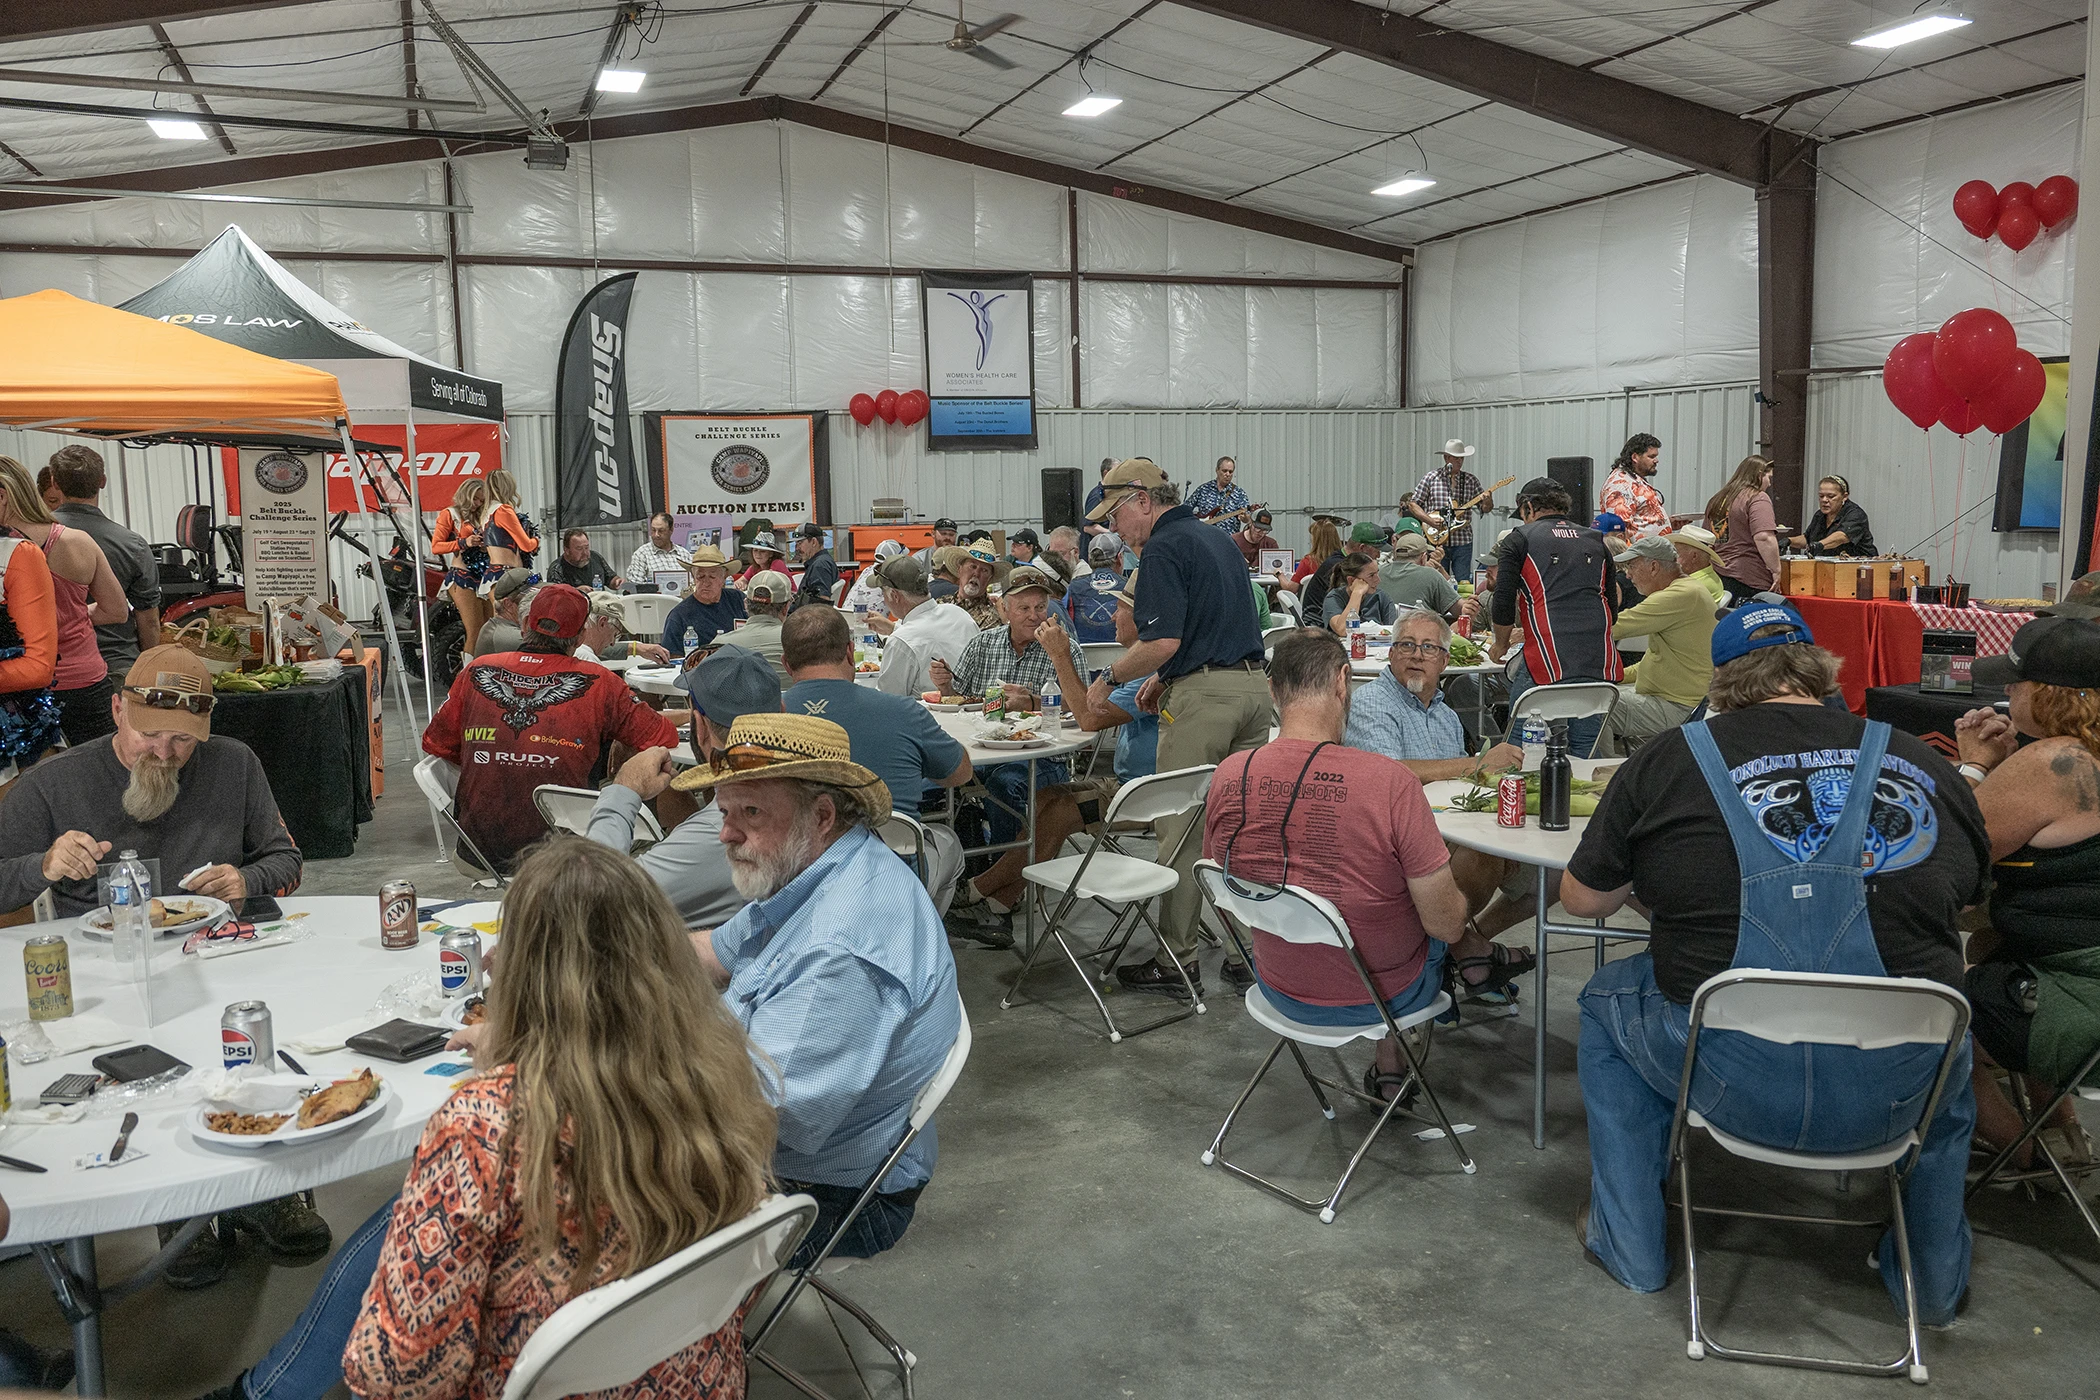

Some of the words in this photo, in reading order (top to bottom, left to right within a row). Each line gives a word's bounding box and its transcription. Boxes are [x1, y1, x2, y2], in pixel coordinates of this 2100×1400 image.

[222, 316, 304, 329] LAW
[430, 376, 454, 406] Serving
[465, 385, 488, 408] Colorado
[715, 450, 732, 464] CAMP
[676, 503, 747, 515] AUCTION
[751, 502, 806, 513] ITEMS!
[249, 514, 291, 522] Challenge
[1551, 528, 1580, 539] WOLFE
[1952, 661, 1972, 670] WIN
[495, 751, 560, 765] RUDY
[499, 761, 554, 769] PROJECT
[1313, 771, 1345, 783] 2022
[25, 959, 68, 975] Coors
[440, 965, 467, 974] EPSI
[222, 1045, 252, 1057] EPSI
